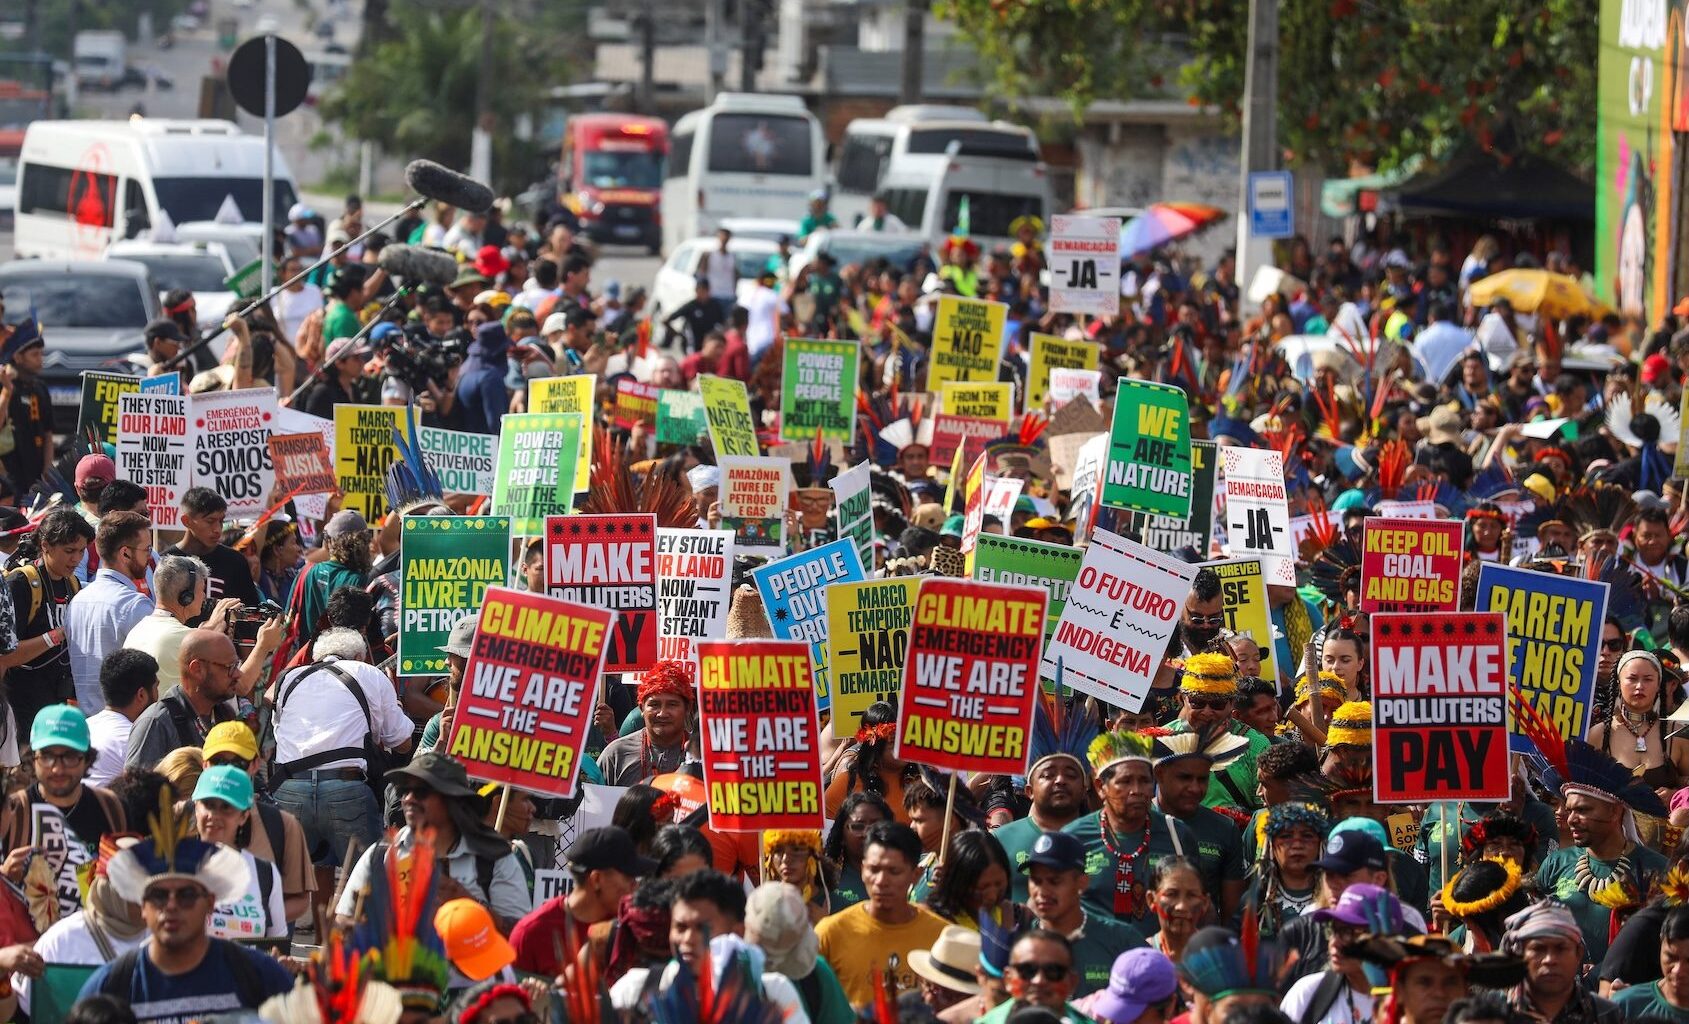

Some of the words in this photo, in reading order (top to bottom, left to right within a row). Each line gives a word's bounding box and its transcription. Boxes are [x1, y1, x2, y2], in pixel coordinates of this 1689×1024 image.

[1053, 240, 1116, 252] DEMARCAÇÃO
[952, 329, 982, 355] NÃO
[798, 352, 844, 369] POWER
[798, 368, 815, 384] TO
[818, 368, 842, 384] THE
[548, 382, 576, 398] MARCO
[794, 384, 842, 401] PEOPLE
[952, 391, 979, 402] FROM
[983, 391, 1000, 402] THE
[122, 397, 152, 414] THEY
[154, 400, 184, 416] STOLE
[206, 406, 260, 420] EMERGÊNCIA
[541, 397, 582, 412] TEMPORAL
[794, 400, 816, 412] NOT
[820, 401, 840, 416] THE
[956, 405, 997, 416] AMAZON
[122, 414, 150, 434] OUR
[154, 416, 186, 436] LAND
[358, 410, 396, 428] MARCO
[706, 406, 752, 434] NATURE
[786, 412, 848, 428] POLLUTERS
[1138, 404, 1181, 442] WE
[142, 436, 168, 452] NOW
[196, 435, 206, 450] A
[208, 428, 274, 448] RESPOSTA
[421, 429, 492, 456] SEMPRE
[514, 430, 563, 450] POWER
[121, 452, 152, 468] THEY
[154, 454, 184, 470] WANT
[196, 446, 274, 476] SOMOS
[284, 452, 324, 478] JUSTA
[514, 450, 532, 468] TO
[534, 450, 560, 467] THE
[1133, 438, 1176, 468] ARE
[128, 468, 142, 484] TO
[146, 470, 177, 486] STEAL
[508, 468, 559, 486] PEOPLE
[728, 468, 780, 481] AMAZÔNIA
[1108, 460, 1190, 498] NATURE
[506, 488, 530, 503] NOT
[532, 487, 556, 502] THE
[729, 492, 777, 505] PETRÓLEO
[733, 482, 760, 492] LIVRE
[762, 482, 774, 492] DE
[1228, 481, 1284, 500] DEMARCAÇÃO
[497, 502, 566, 518] POLLUTERS
[739, 506, 744, 516] E
[1245, 508, 1274, 550] JÁ
[679, 536, 724, 555] STOLE
[1366, 528, 1418, 554] KEEP
[1422, 532, 1459, 560] OIL,
[406, 557, 504, 580] AMAZÔNIA
[551, 542, 652, 584] MAKE
[676, 556, 724, 579] LAND
[1215, 561, 1260, 578] FOREVER
[1383, 553, 1442, 582] COAL,
[768, 551, 848, 600] PEOPLE
[406, 581, 468, 609] LIVRE
[661, 578, 695, 598] NOW
[857, 584, 907, 609] MARCO
[1080, 566, 1097, 589] O
[1095, 573, 1177, 622] FUTURO
[1366, 577, 1409, 602] AND
[1413, 579, 1455, 603] GAS
[674, 599, 720, 619] WANT
[848, 605, 914, 633] TEMPORA
[917, 593, 1041, 635] CLIMATE
[1110, 608, 1124, 630] É
[1489, 585, 1593, 646] PAREM
[482, 601, 605, 655] CLIMATE
[663, 618, 708, 637] STEAL
[859, 628, 907, 670] NÃO
[914, 627, 1038, 660] EMERGENCY
[1056, 621, 1151, 678] INDÍGENA
[474, 635, 600, 680] EMERGENCY
[1378, 645, 1500, 694] MAKE
[1522, 640, 1584, 695] NOS
[702, 655, 810, 689] CLIMATE
[916, 653, 964, 690] WE
[966, 660, 1027, 696] ARE
[472, 662, 521, 703] WE
[522, 673, 585, 716] ARE
[702, 690, 812, 714] EMERGENCY
[949, 694, 985, 719] THE
[1379, 697, 1501, 724] POLLUTERS
[502, 706, 538, 733] THE
[708, 718, 748, 752] WE
[755, 717, 809, 752] ARE
[903, 714, 1024, 759] ANSWER
[451, 724, 574, 780] ANSWER
[1389, 730, 1493, 792] PAY
[740, 755, 776, 778] THE
[711, 782, 818, 815] ANSWER
